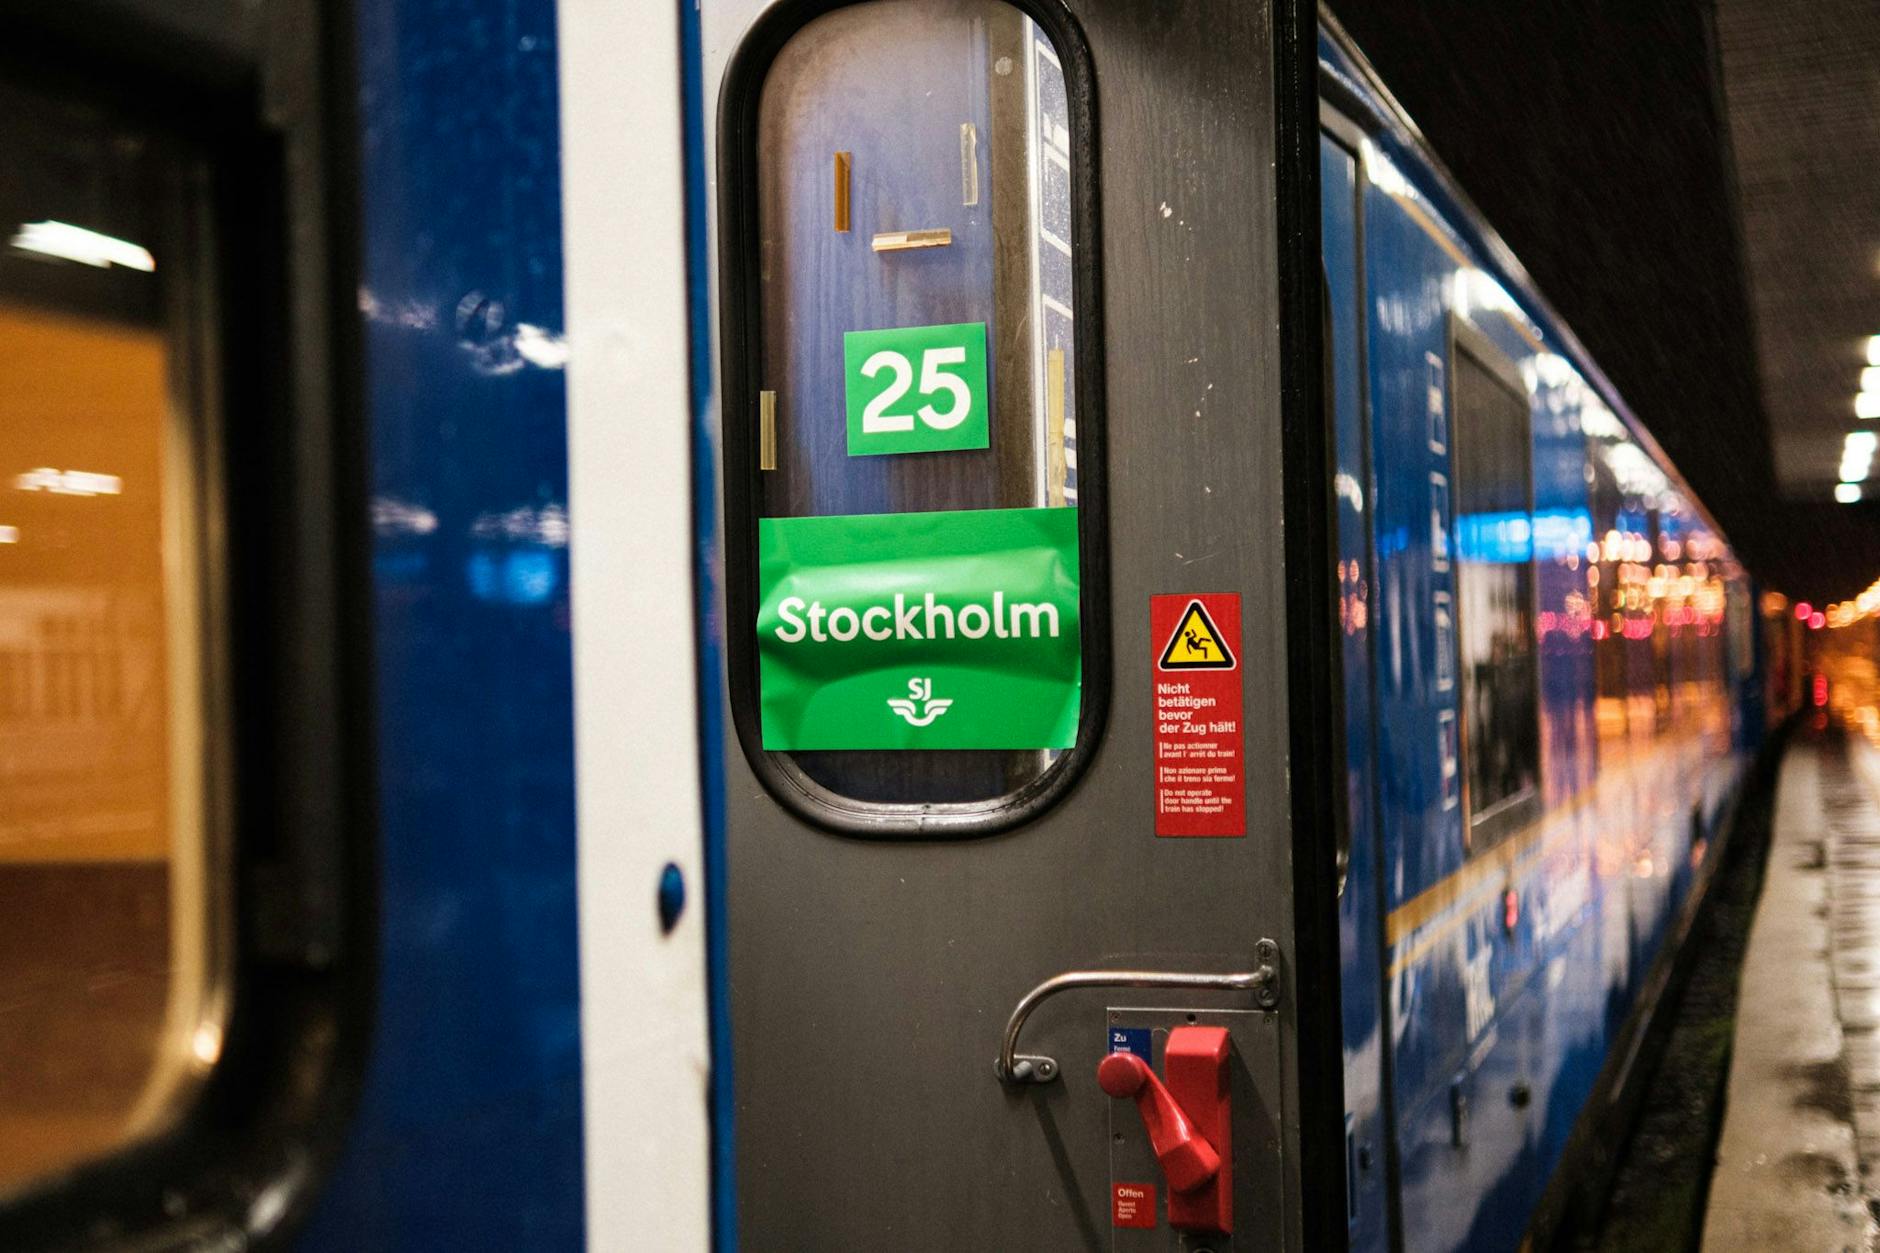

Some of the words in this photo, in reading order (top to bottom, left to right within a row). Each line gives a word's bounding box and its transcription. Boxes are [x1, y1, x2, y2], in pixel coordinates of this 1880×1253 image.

[860, 346, 972, 434] 25
[774, 591, 1060, 644] Stockholm
[907, 677, 932, 702] SJ
[1157, 683, 1190, 694] Nicht
[1158, 696, 1217, 709] betätigen
[1158, 709, 1193, 720] bevor
[1159, 722, 1180, 734] der
[1182, 721, 1207, 735] Zug
[1209, 721, 1236, 733] hält!
[1114, 1033, 1127, 1042] Zu
[1118, 1188, 1144, 1198] Offen
